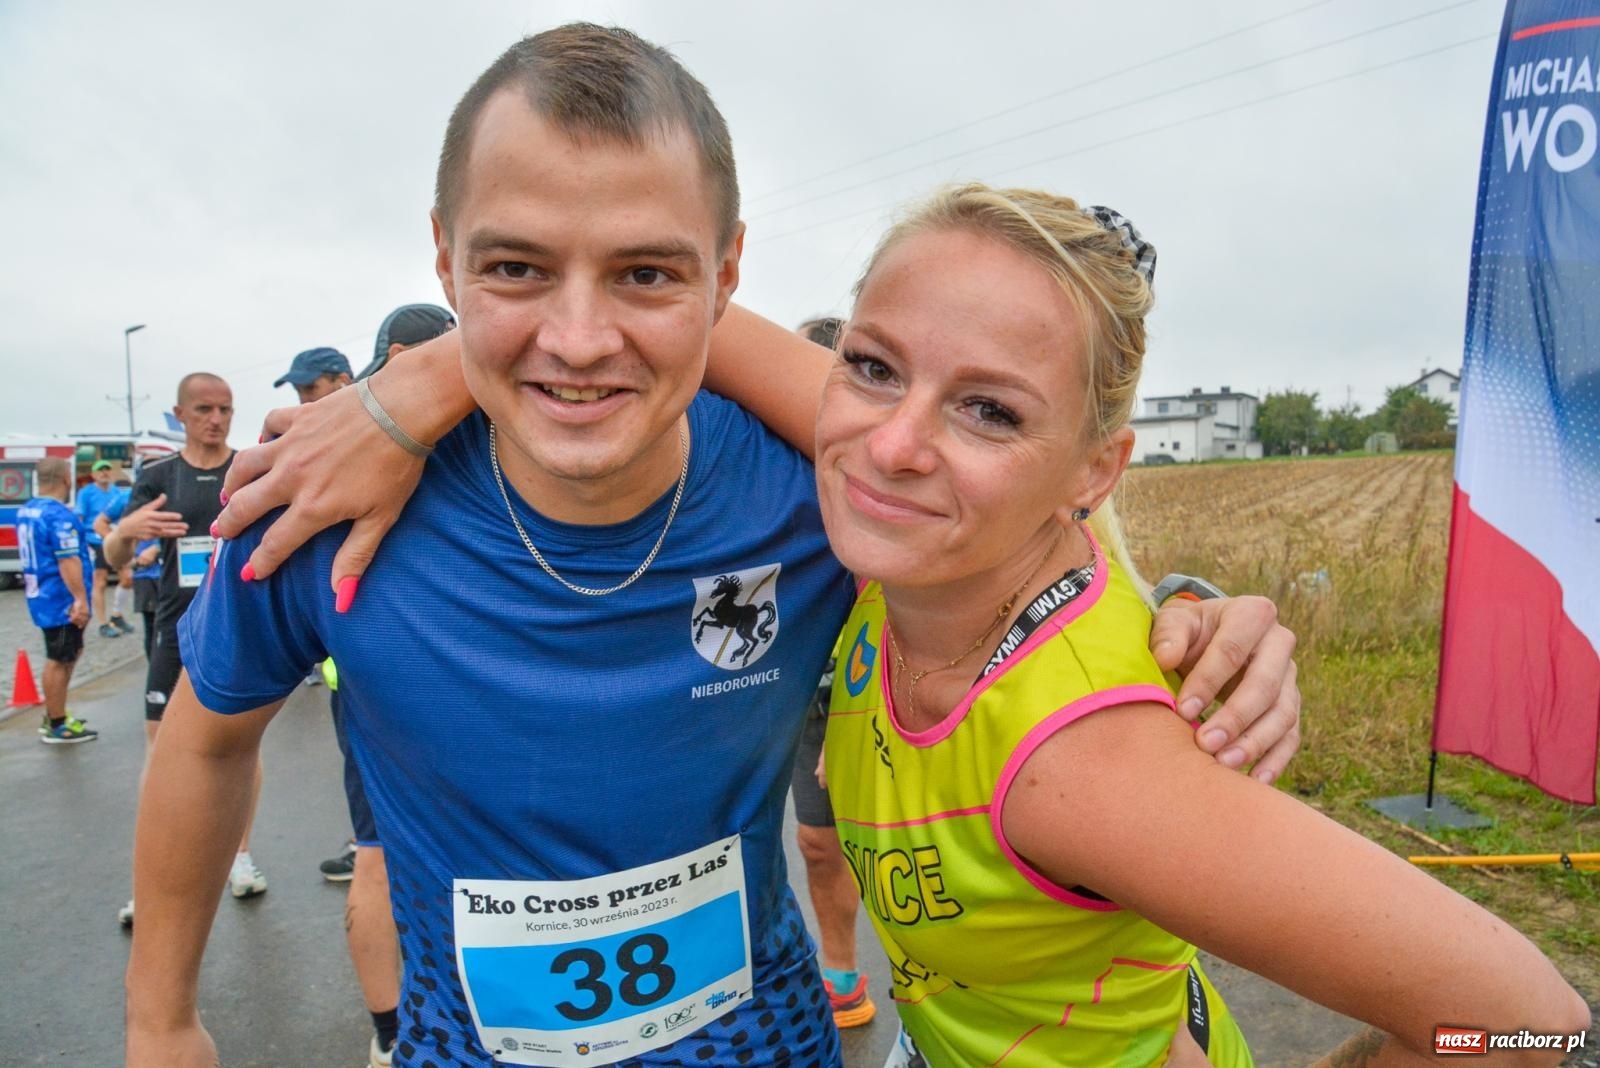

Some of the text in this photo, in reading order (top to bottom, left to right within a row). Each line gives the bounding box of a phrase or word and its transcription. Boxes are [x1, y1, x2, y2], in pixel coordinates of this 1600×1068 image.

[1033, 579, 1077, 617] GYM
[691, 667, 780, 699] NIEBOROWICE
[468, 853, 728, 915] Eko Cross przez Las
[526, 920, 571, 933] Kornice,
[573, 917, 588, 929] 30
[590, 908, 639, 926] września
[641, 897, 669, 914] 2023
[549, 932, 677, 1022] 38
